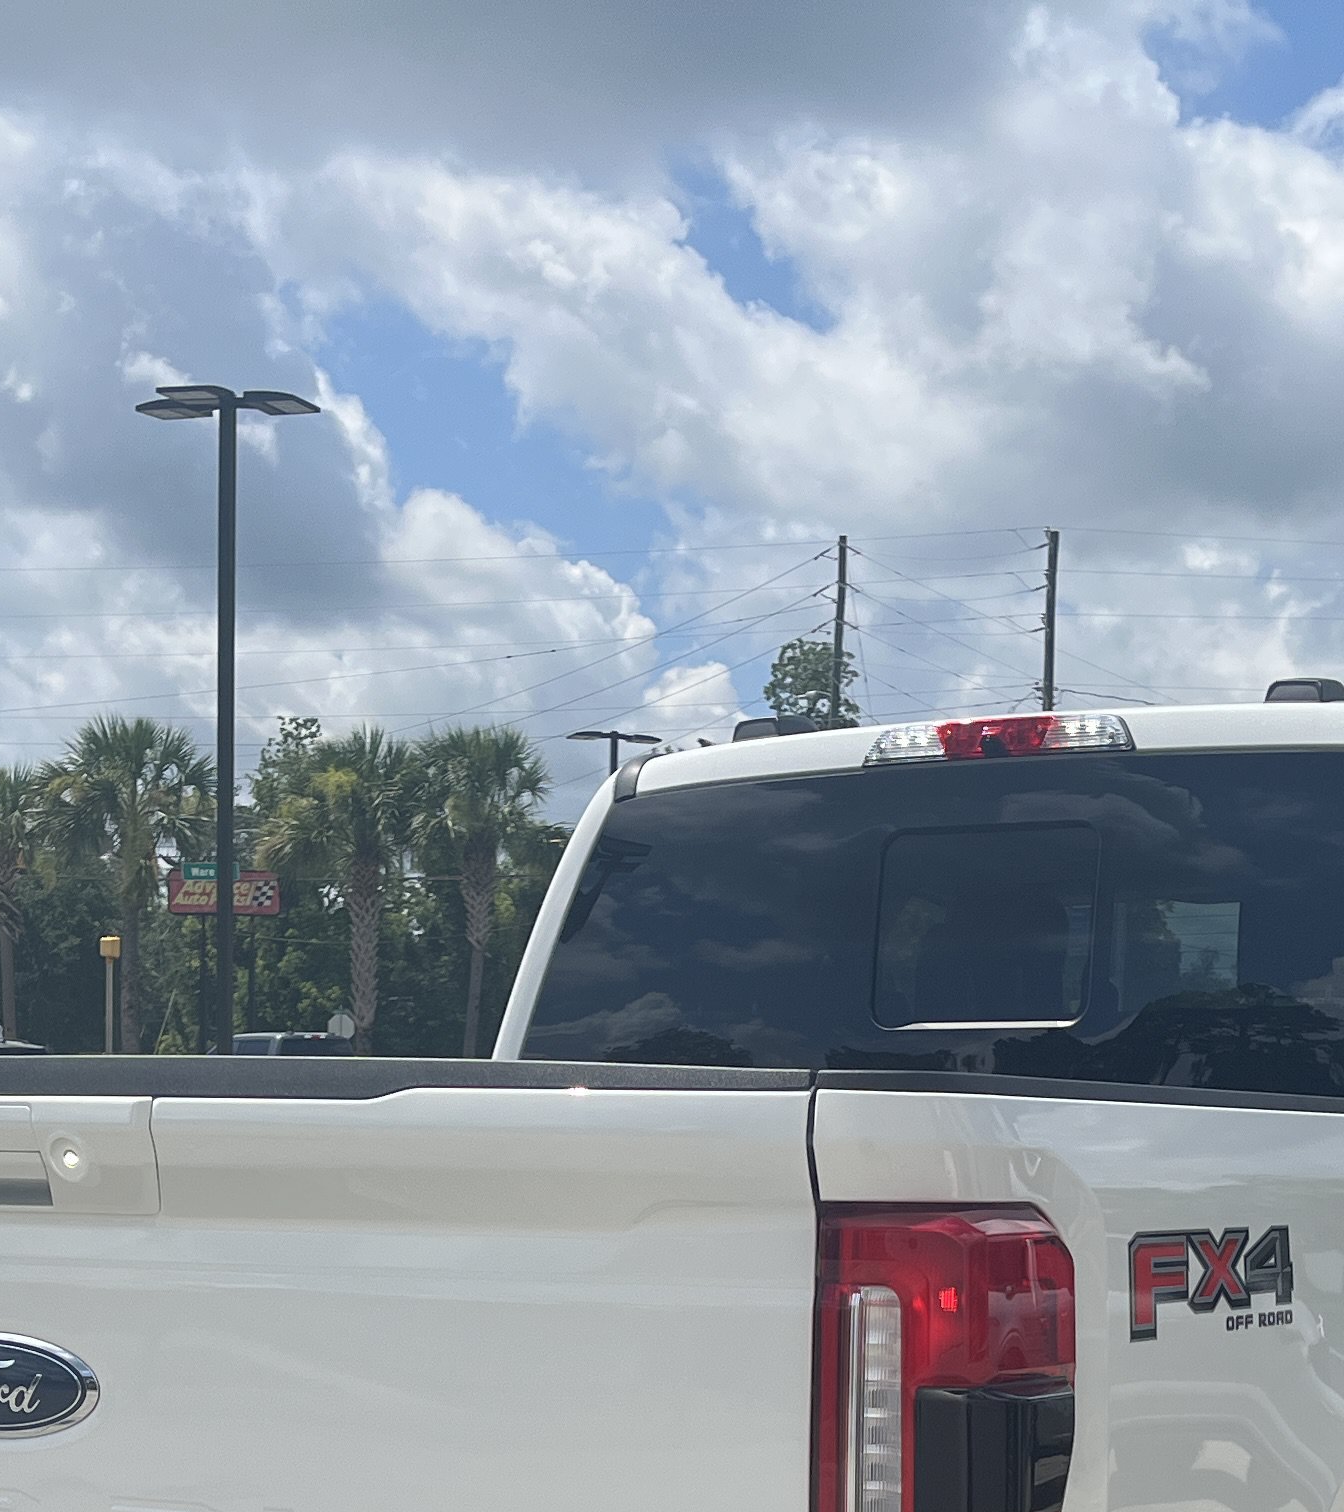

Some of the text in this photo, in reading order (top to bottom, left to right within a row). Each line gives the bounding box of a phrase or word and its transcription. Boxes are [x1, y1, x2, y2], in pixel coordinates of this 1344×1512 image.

[191, 867, 216, 877] Ware
[177, 880, 251, 894] Advce
[1128, 1225, 1294, 1343] FX4
[1226, 1310, 1293, 1331] OFF ROAD
